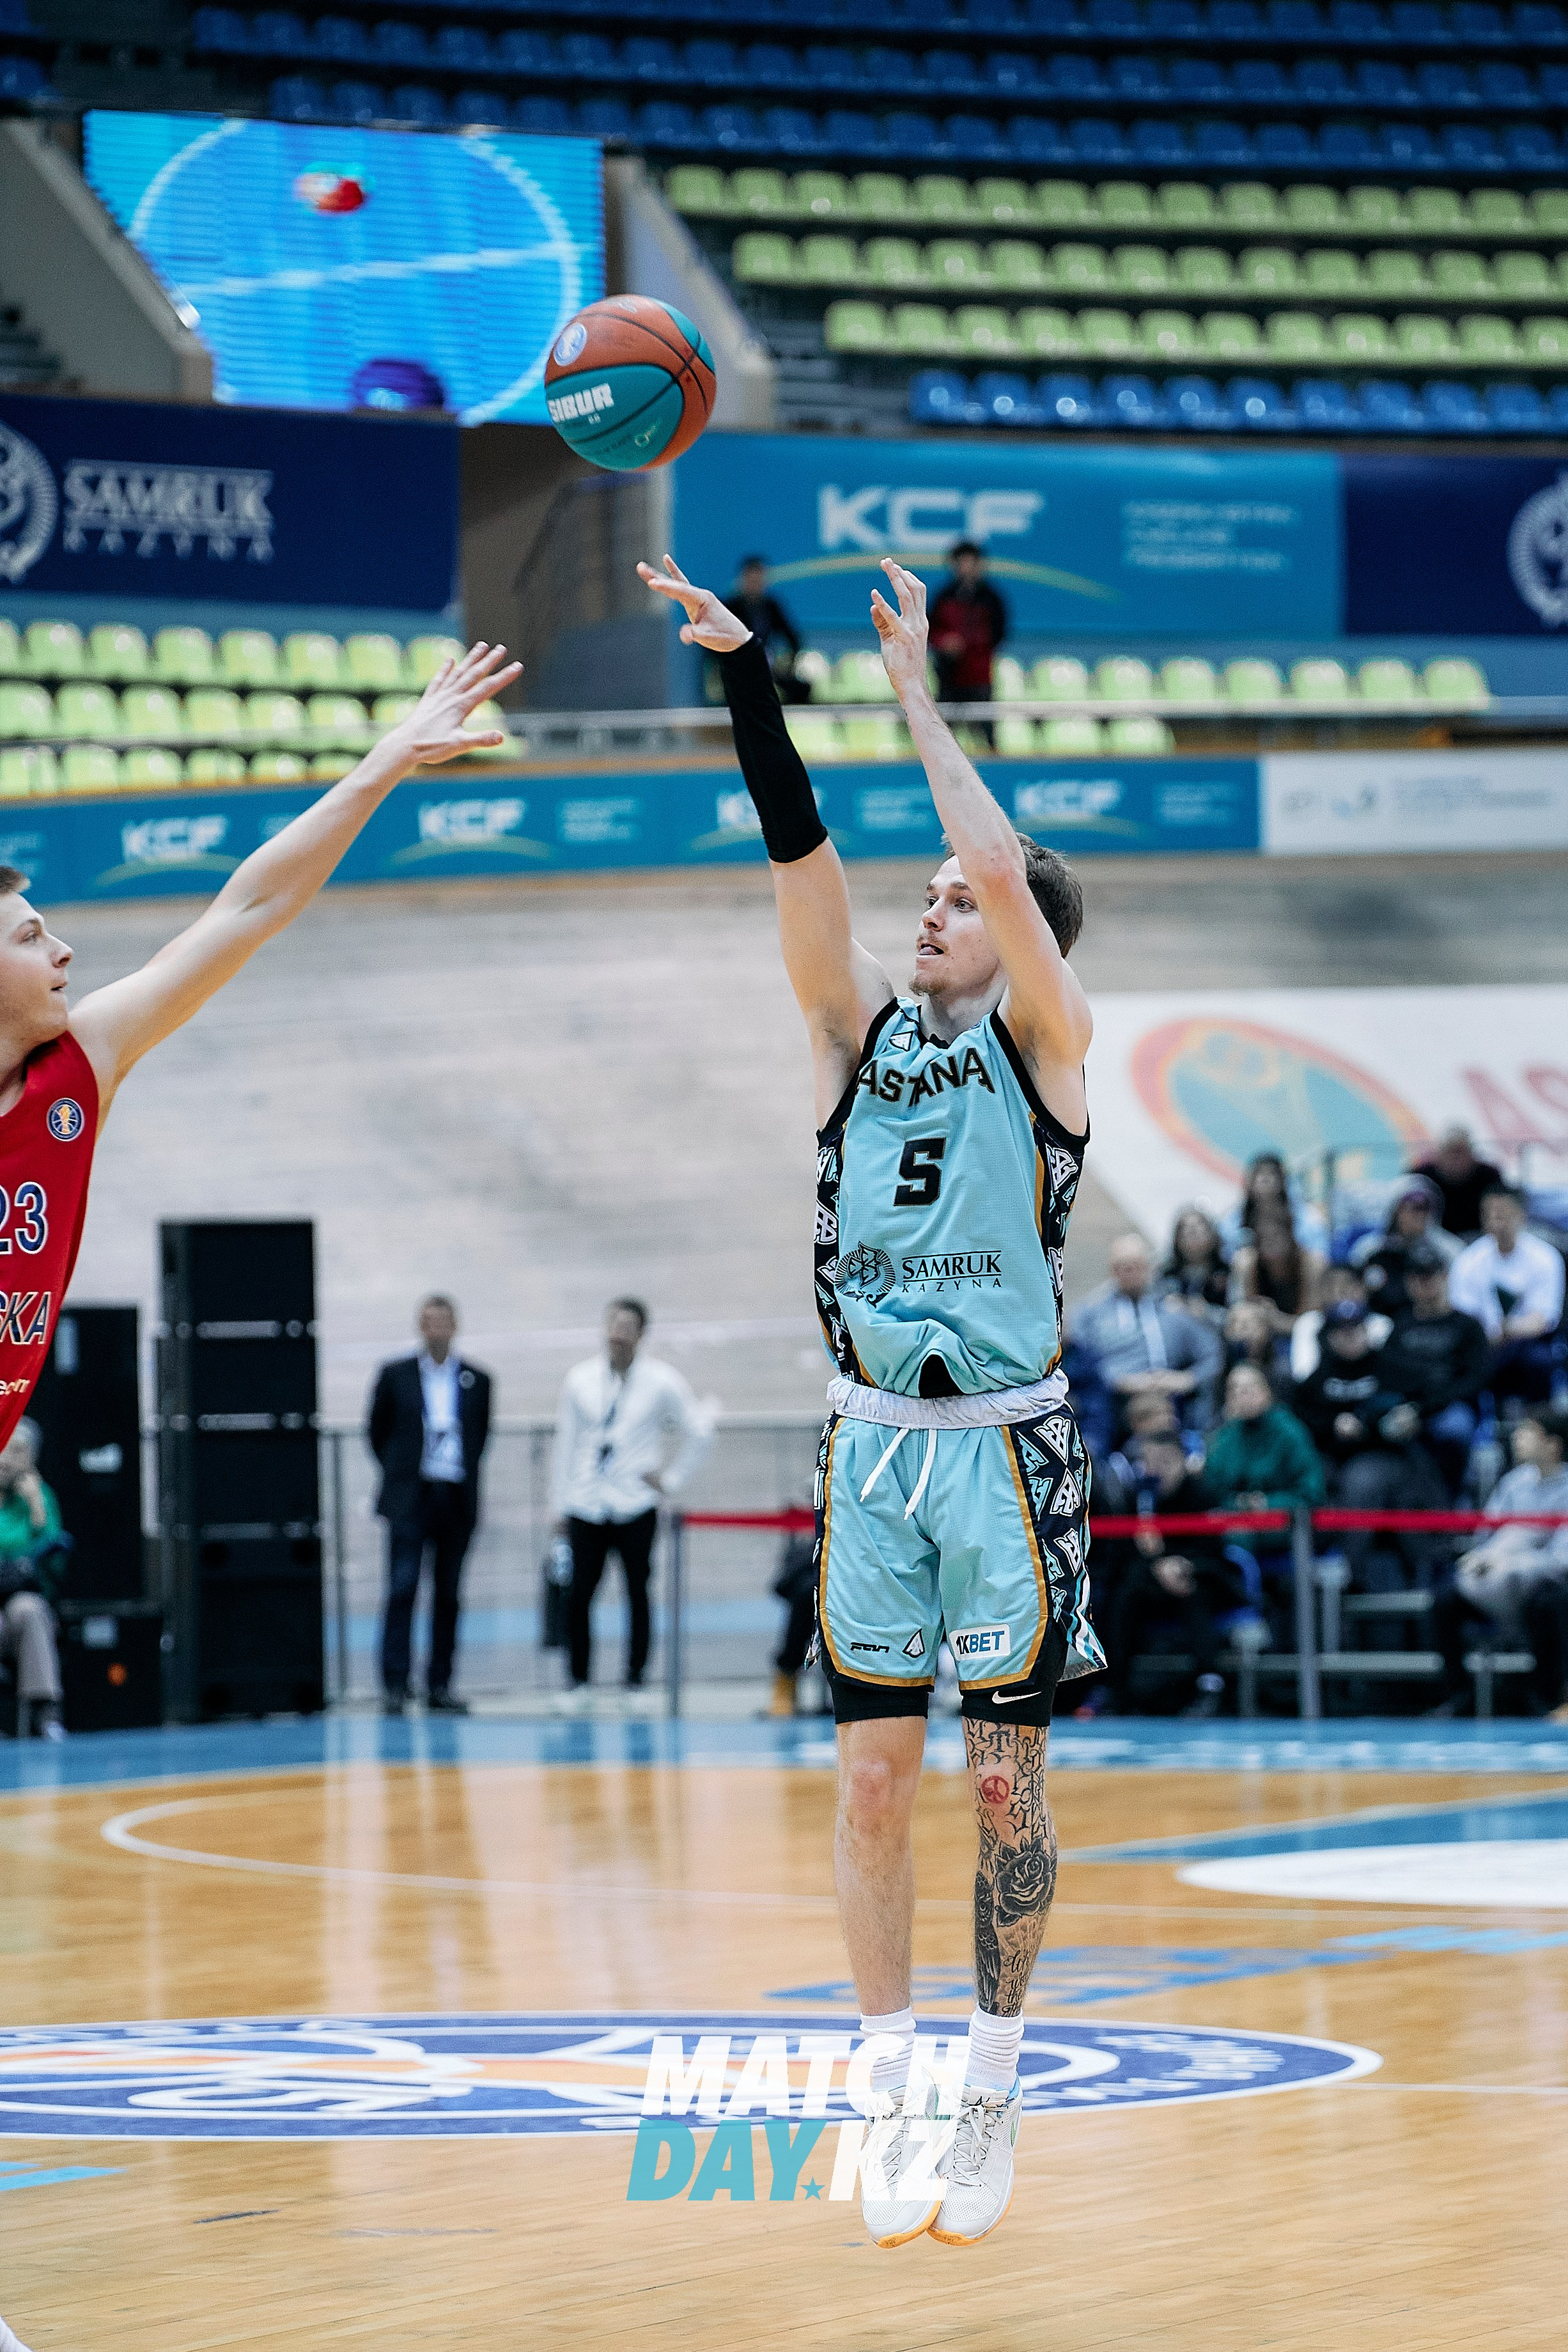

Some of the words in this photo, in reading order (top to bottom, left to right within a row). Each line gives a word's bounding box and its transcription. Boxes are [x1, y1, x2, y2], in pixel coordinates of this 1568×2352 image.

[548, 383, 614, 423] SIBUR
[65, 465, 274, 524] SAMRUK
[819, 483, 1044, 550] KCF
[419, 799, 525, 843] KCF
[1015, 780, 1125, 822] KCF
[122, 815, 229, 861] KCF
[855, 1047, 995, 1107] ASTANA
[893, 1137, 947, 1207] 5
[902, 1253, 1002, 1280] SAMRUK
[902, 1278, 1002, 1293] KAZYNA
